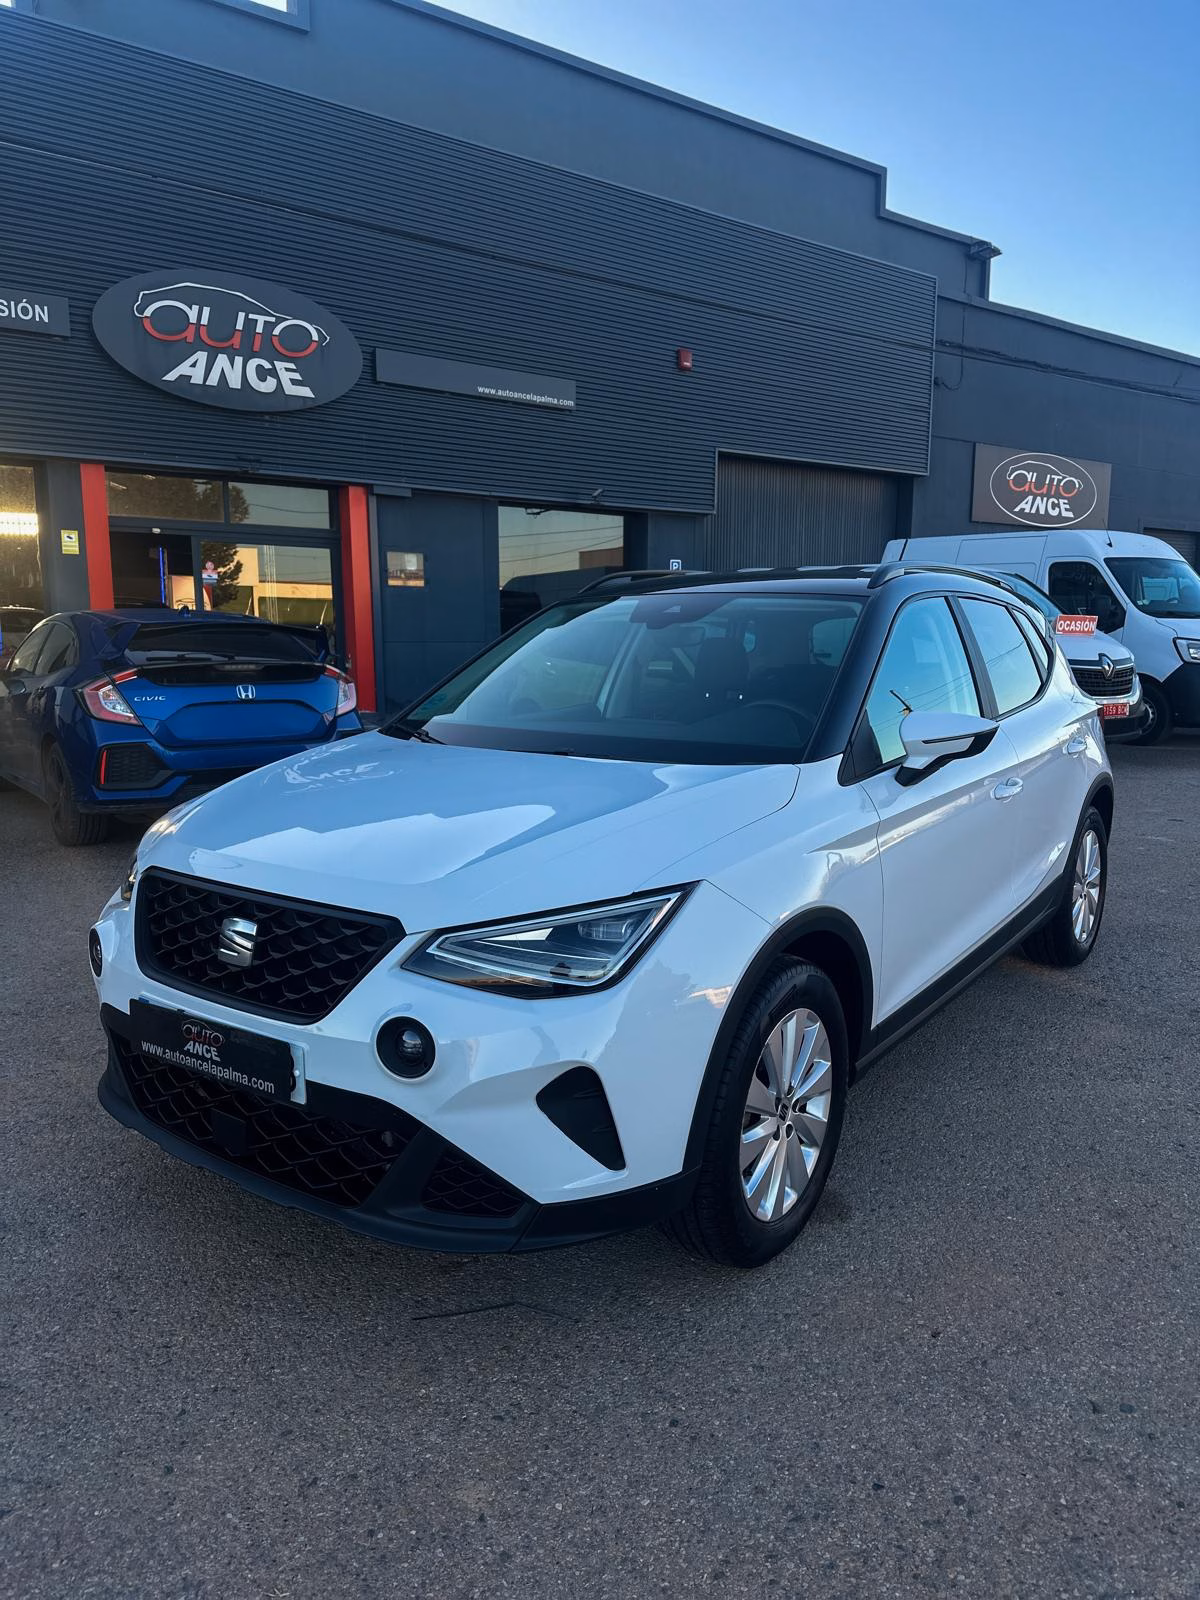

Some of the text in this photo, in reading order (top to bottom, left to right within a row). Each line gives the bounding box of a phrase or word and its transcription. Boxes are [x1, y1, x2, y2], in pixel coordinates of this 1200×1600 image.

[161, 351, 316, 398] ANCE
[477, 386, 575, 407] www.autoancelapalma.com
[1013, 496, 1075, 518] ANCE
[1058, 619, 1097, 632] OCASIÓN
[184, 1041, 221, 1062] ANCE
[141, 1040, 275, 1095] www.autoancelapalma.com
